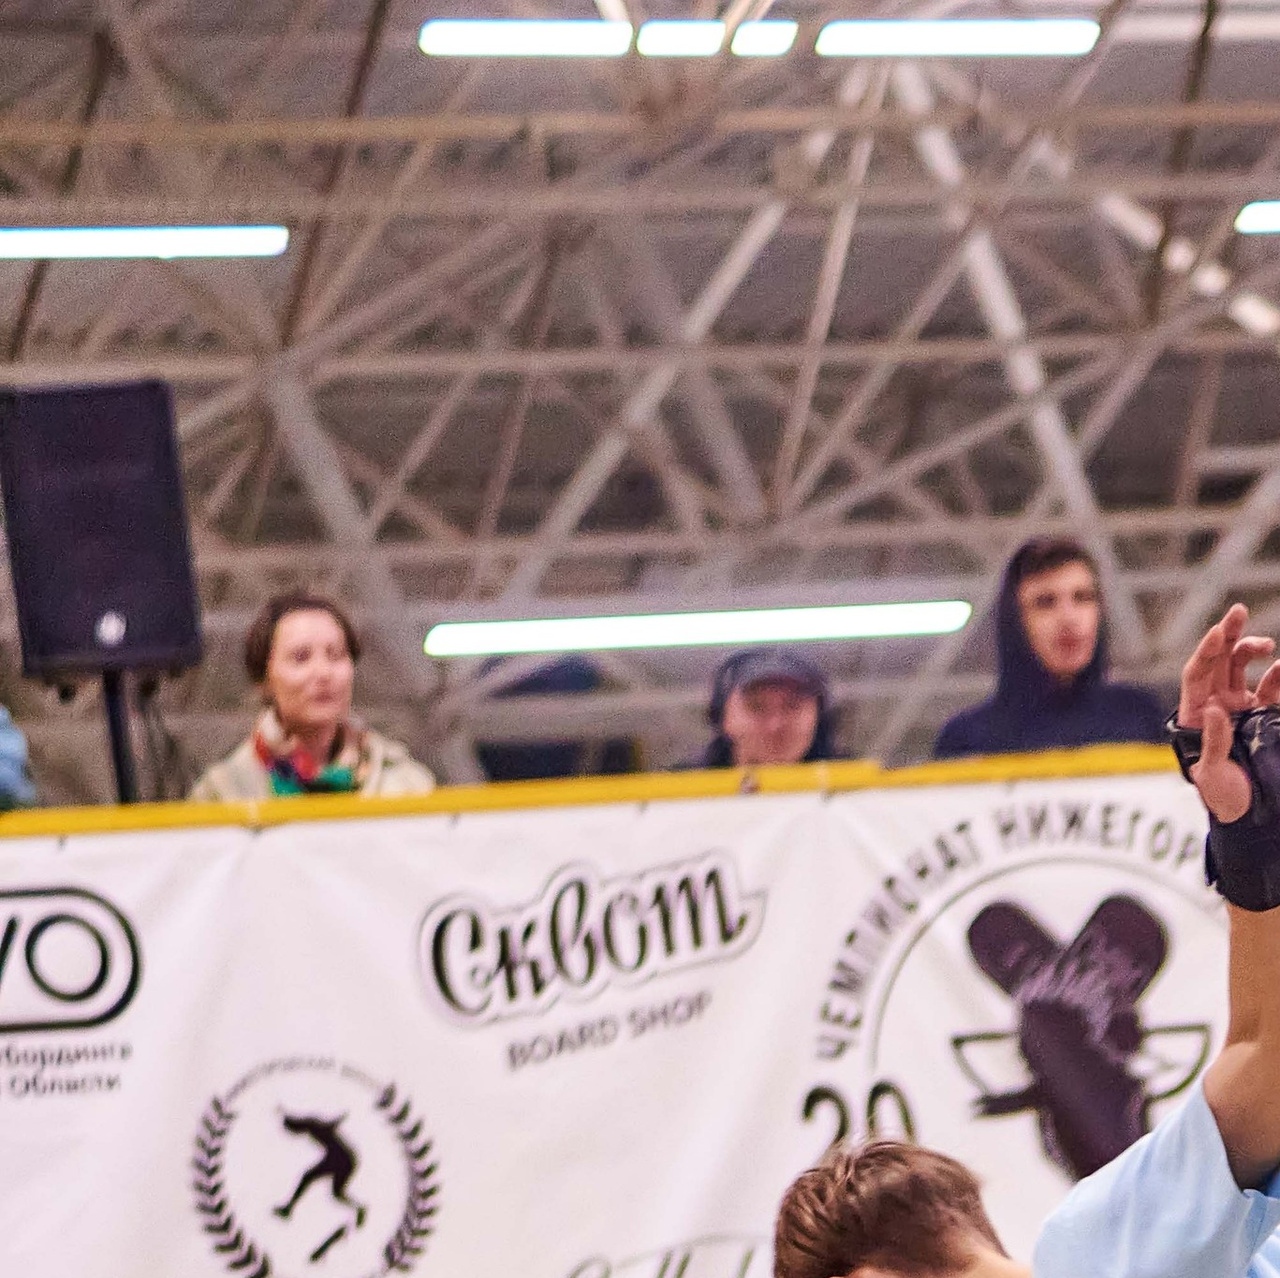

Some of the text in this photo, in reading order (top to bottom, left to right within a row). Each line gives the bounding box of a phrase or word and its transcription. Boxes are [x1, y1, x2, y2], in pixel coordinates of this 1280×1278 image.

[992, 801, 1202, 870] НИЖЕГОР
[0, 1044, 133, 1071] бординга
[506, 991, 712, 1071] BOARD SHOP
